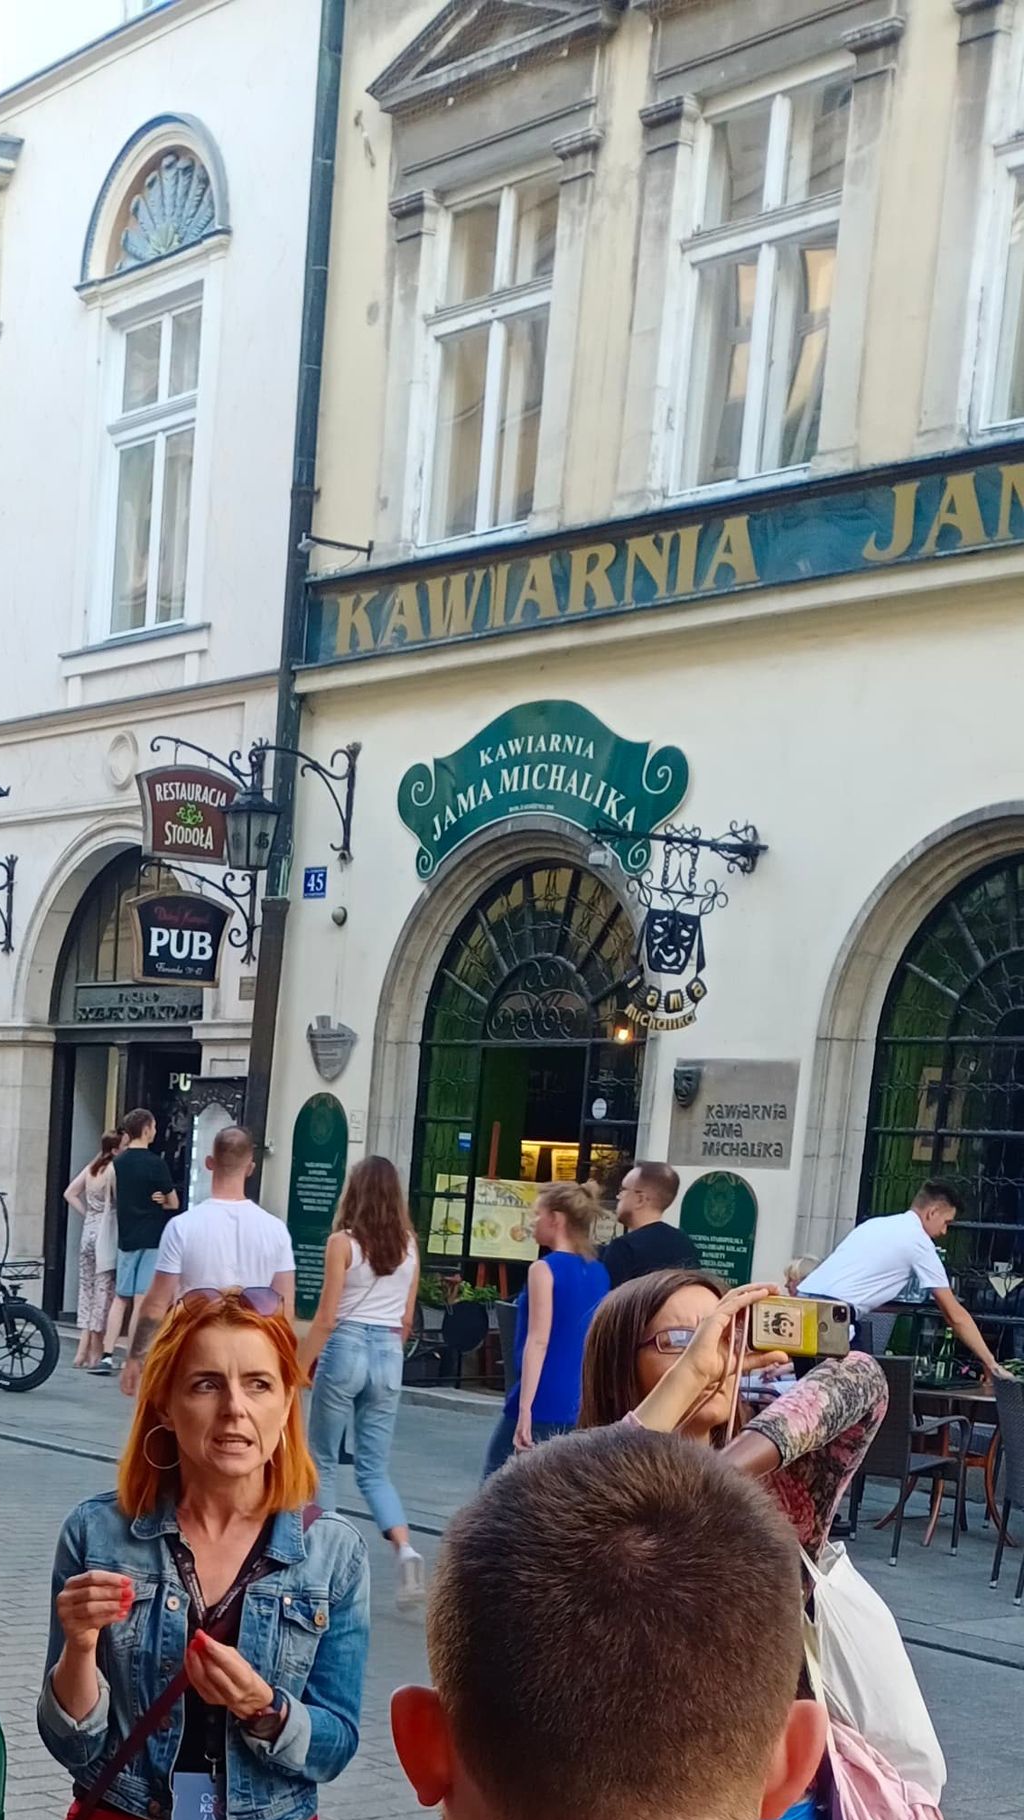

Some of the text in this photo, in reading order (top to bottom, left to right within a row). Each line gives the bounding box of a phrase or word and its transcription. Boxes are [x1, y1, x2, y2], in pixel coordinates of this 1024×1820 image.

[333, 515, 762, 656] KAWIARNIA
[479, 734, 595, 767] KAWIARNIA
[155, 782, 227, 807] RESTAURACJA
[433, 763, 637, 841] JAMA MICHALIKA
[164, 821, 214, 850] STODOŁA
[307, 873, 324, 891] 45
[148, 927, 213, 960] PUB
